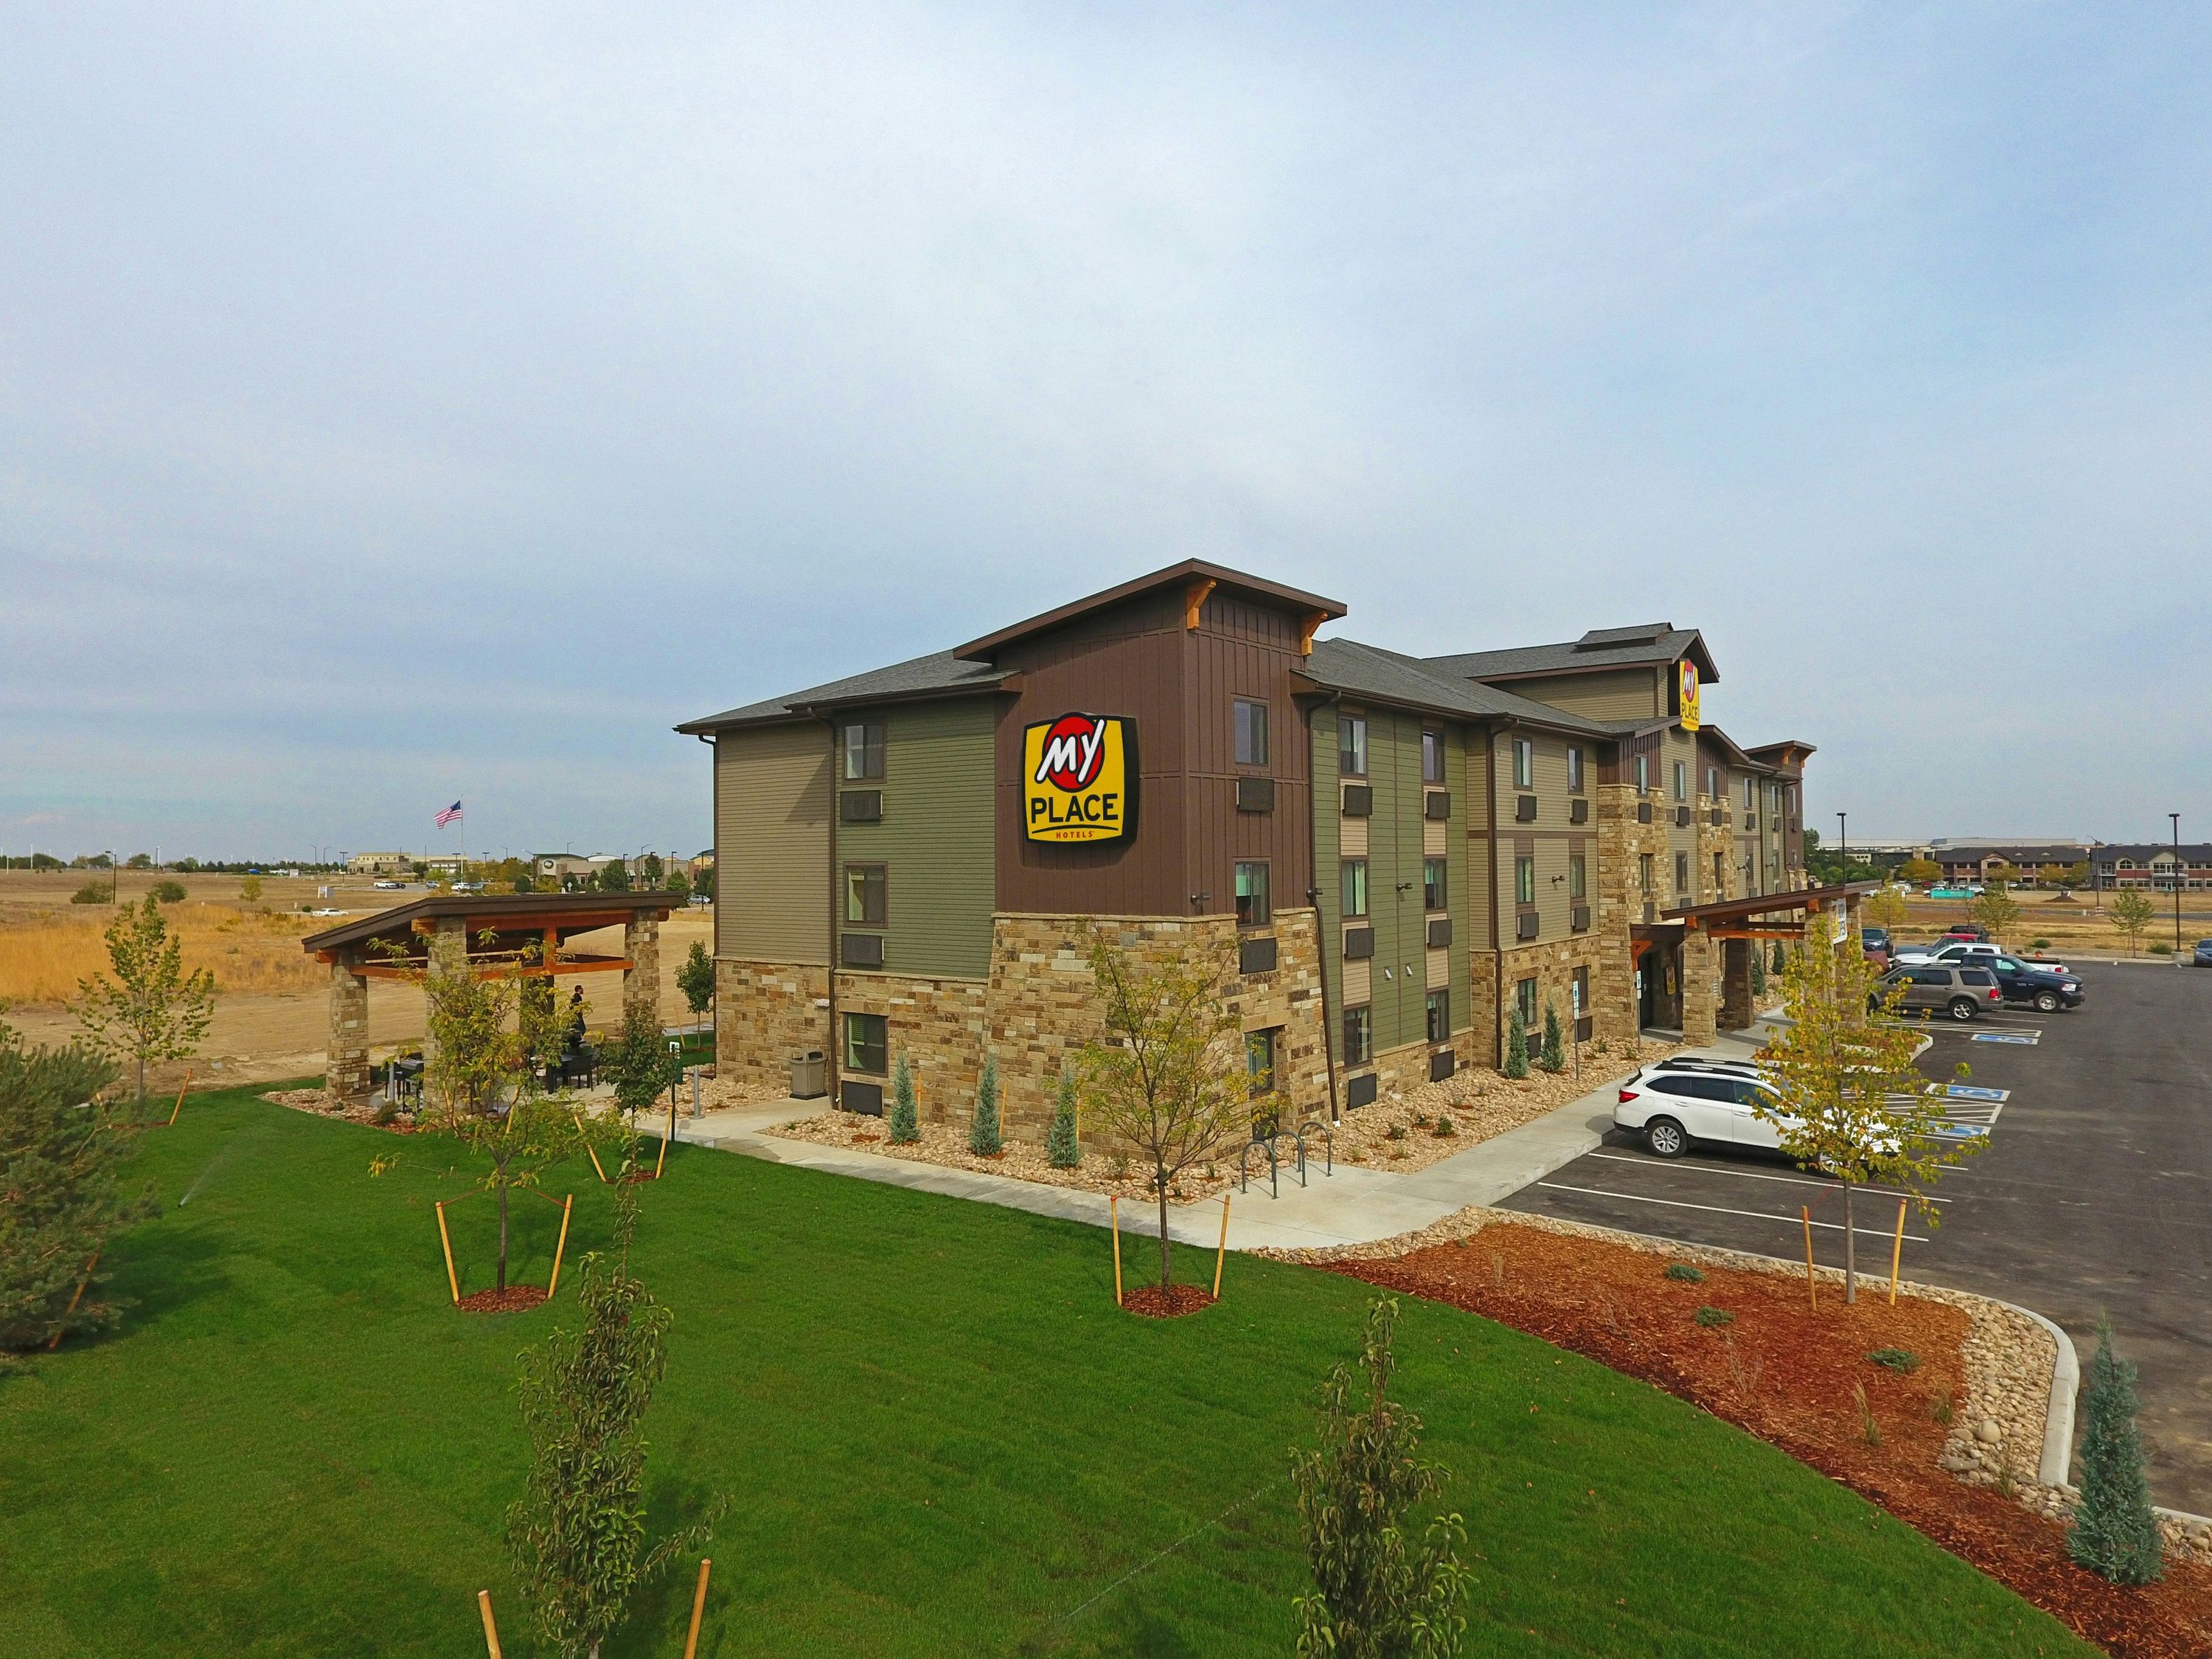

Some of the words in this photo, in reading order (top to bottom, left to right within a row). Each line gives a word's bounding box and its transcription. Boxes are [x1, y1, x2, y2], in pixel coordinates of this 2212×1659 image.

[1682, 702, 1698, 721] PLACE
[1031, 793, 1119, 824] PLACE
[1056, 830, 1094, 839] HOTELS
